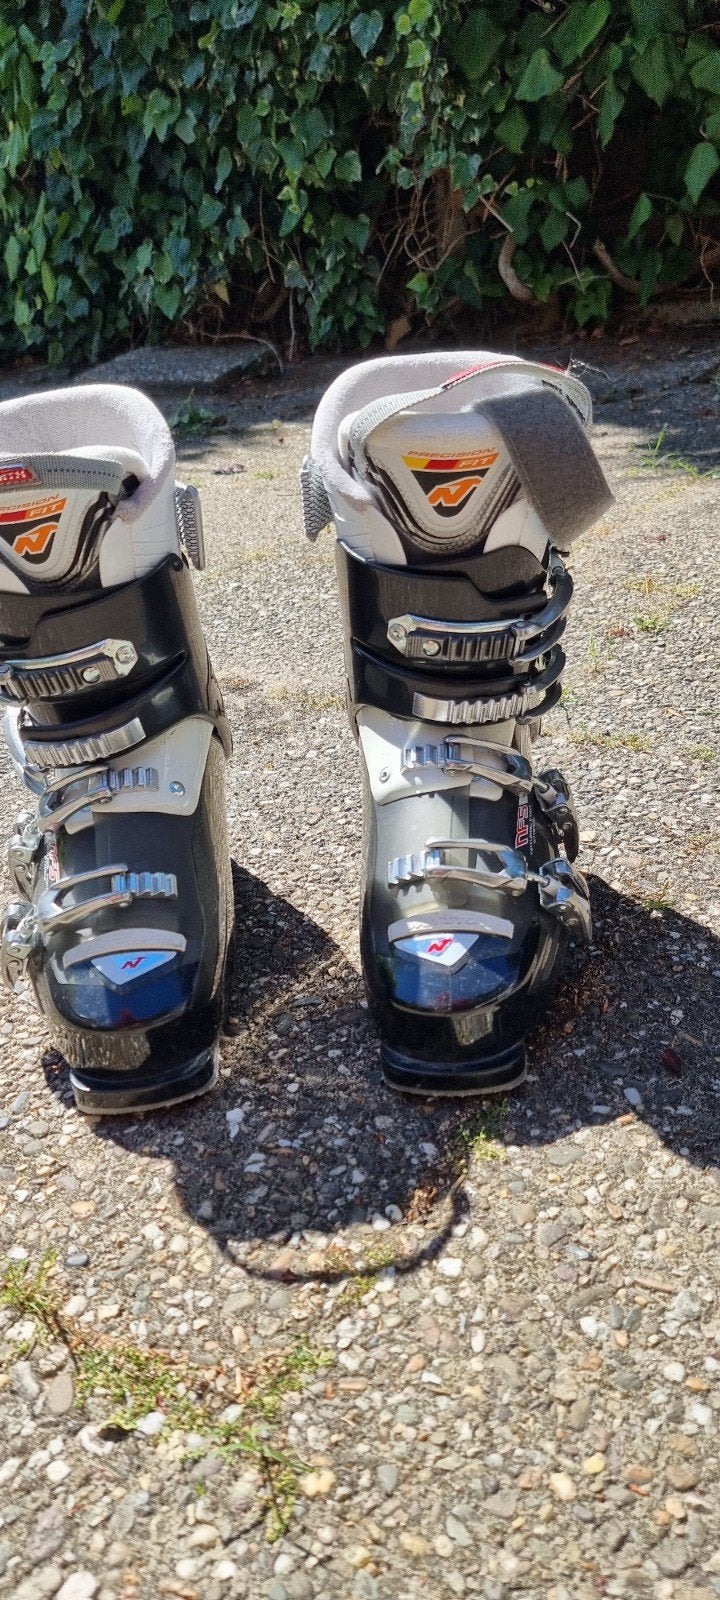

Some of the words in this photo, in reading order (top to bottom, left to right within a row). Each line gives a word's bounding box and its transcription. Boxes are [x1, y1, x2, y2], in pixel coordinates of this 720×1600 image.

[407, 447, 495, 458] PRECISION
[458, 457, 491, 468] FIT
[29, 502, 62, 517] FIT
